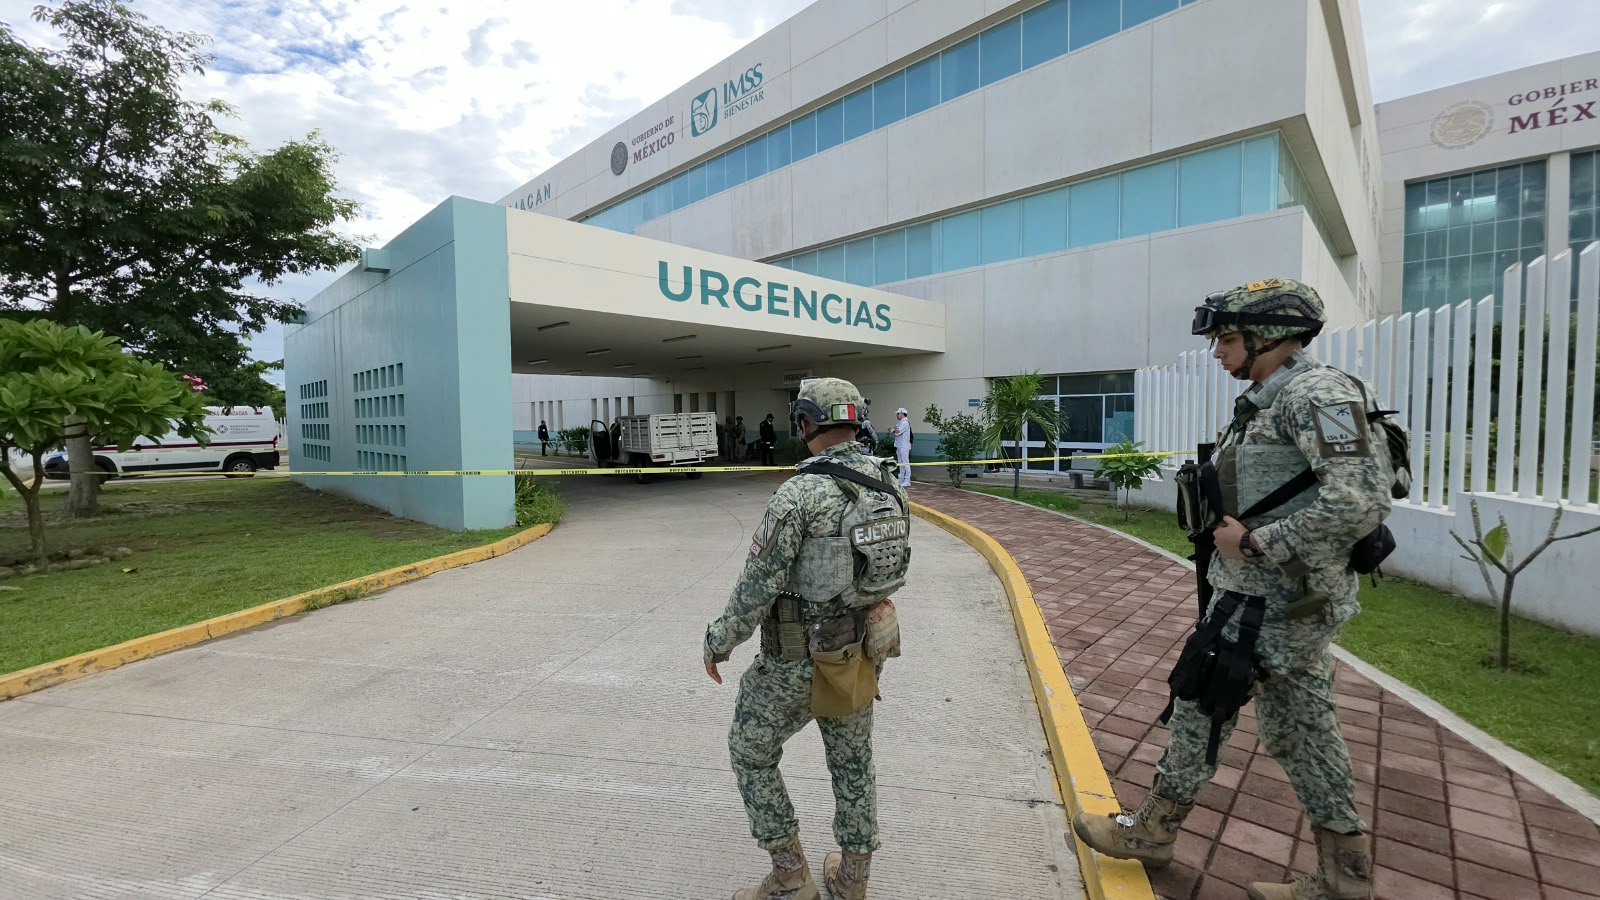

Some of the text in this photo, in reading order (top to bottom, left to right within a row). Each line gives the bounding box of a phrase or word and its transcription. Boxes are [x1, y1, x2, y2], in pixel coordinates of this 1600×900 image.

[723, 62, 763, 105] IMSS
[1508, 78, 1600, 106] GOBIER
[724, 90, 764, 120] BIENESTAR
[1507, 97, 1597, 134] MÉX
[631, 115, 675, 146] GOBIERNO DE
[633, 132, 675, 164] MÉXICO
[658, 260, 892, 332] URGENCIAS
[855, 520, 906, 544] EJÉRCITO
